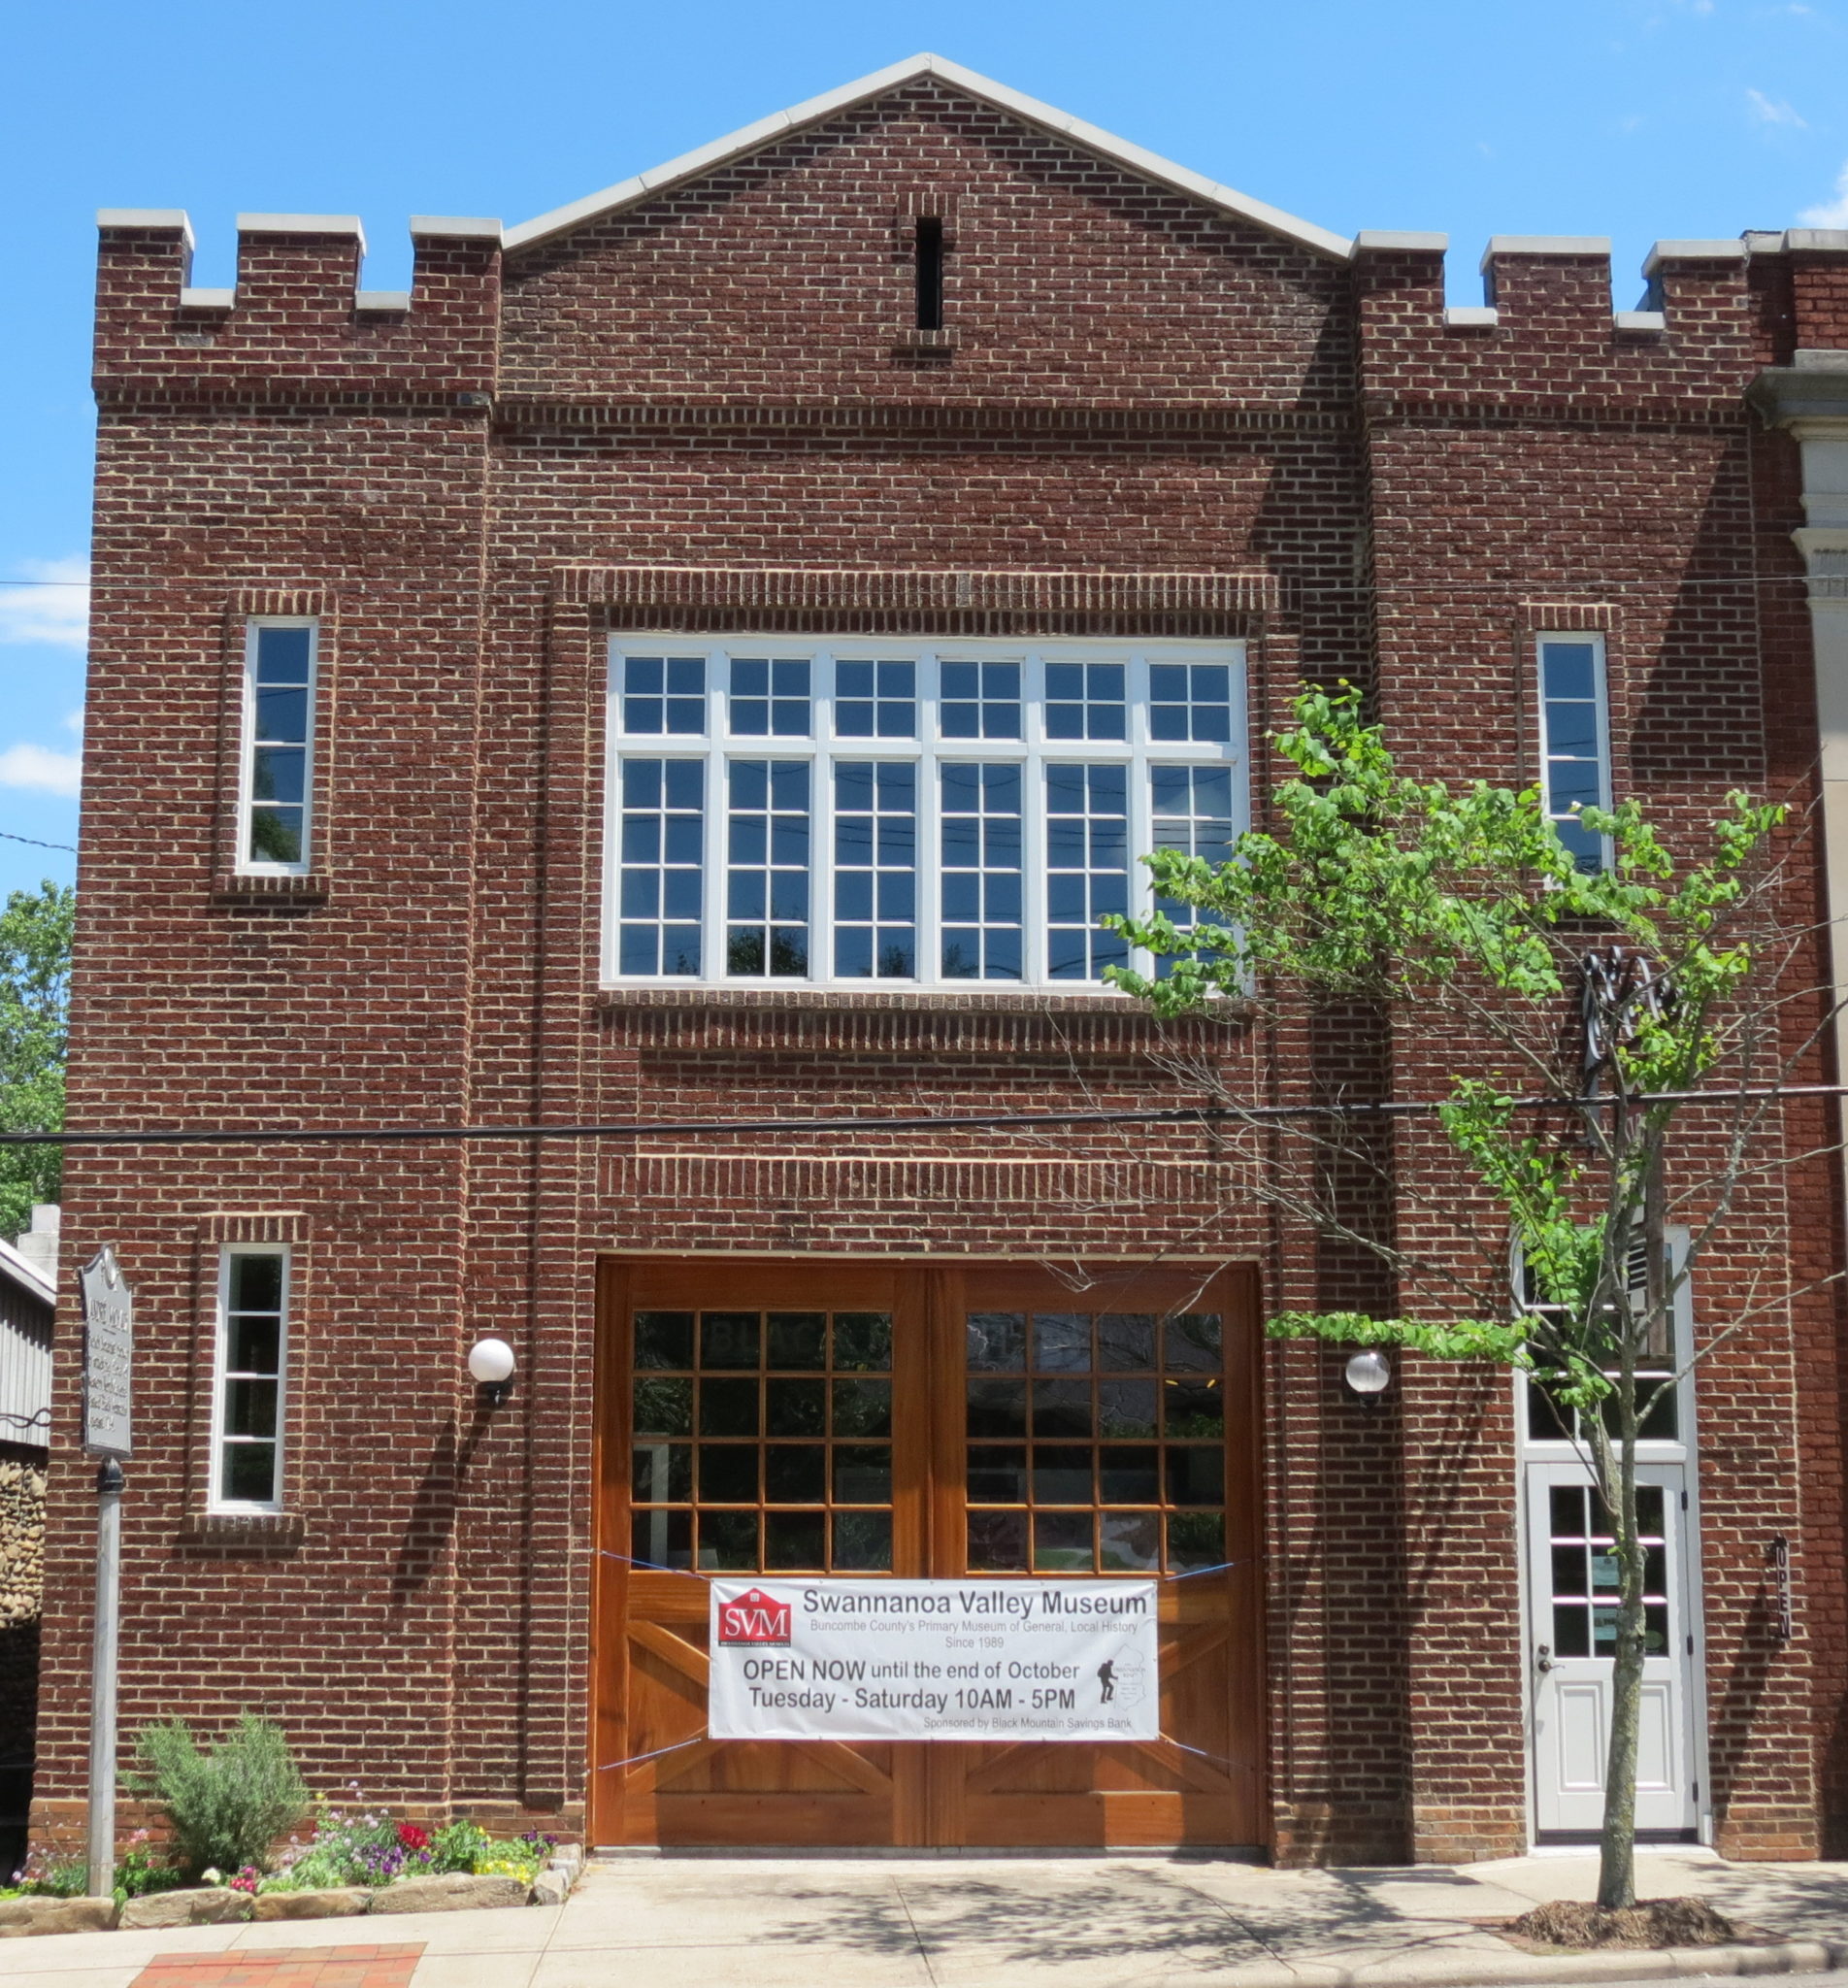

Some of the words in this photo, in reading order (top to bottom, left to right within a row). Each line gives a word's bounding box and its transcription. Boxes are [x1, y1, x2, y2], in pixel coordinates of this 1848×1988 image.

[803, 1589, 951, 1614] Swannanoa
[959, 1591, 1033, 1620] Valley
[1041, 1590, 1147, 1614] Museum
[1778, 1546, 1791, 1640] OPEN
[724, 1607, 788, 1637] SVM
[810, 1619, 867, 1632] Buncombe
[870, 1620, 914, 1634] County's
[918, 1620, 959, 1635] Primary
[962, 1620, 1006, 1632] Museum
[1009, 1620, 1021, 1632] of
[1072, 1621, 1099, 1632] Local
[1102, 1619, 1138, 1635] History
[946, 1637, 974, 1648] Since
[979, 1637, 1004, 1648] 1989
[743, 1659, 805, 1680] OPEN
[812, 1660, 866, 1680] NOW
[872, 1662, 908, 1677] until
[914, 1662, 940, 1678] the
[947, 1662, 978, 1678] end
[985, 1662, 1002, 1678] of
[1008, 1662, 1079, 1678] October
[749, 1687, 836, 1713] Tuesday
[855, 1688, 947, 1714] Saturday
[955, 1689, 1011, 1708] 10AM
[1033, 1689, 1074, 1708] 5PM
[924, 1717, 974, 1729] Sponsored
[977, 1717, 989, 1730] by
[993, 1717, 1017, 1728] Black
[1021, 1717, 1064, 1728] Mountain
[1068, 1718, 1105, 1730] Savings
[1107, 1718, 1132, 1728] Bank
